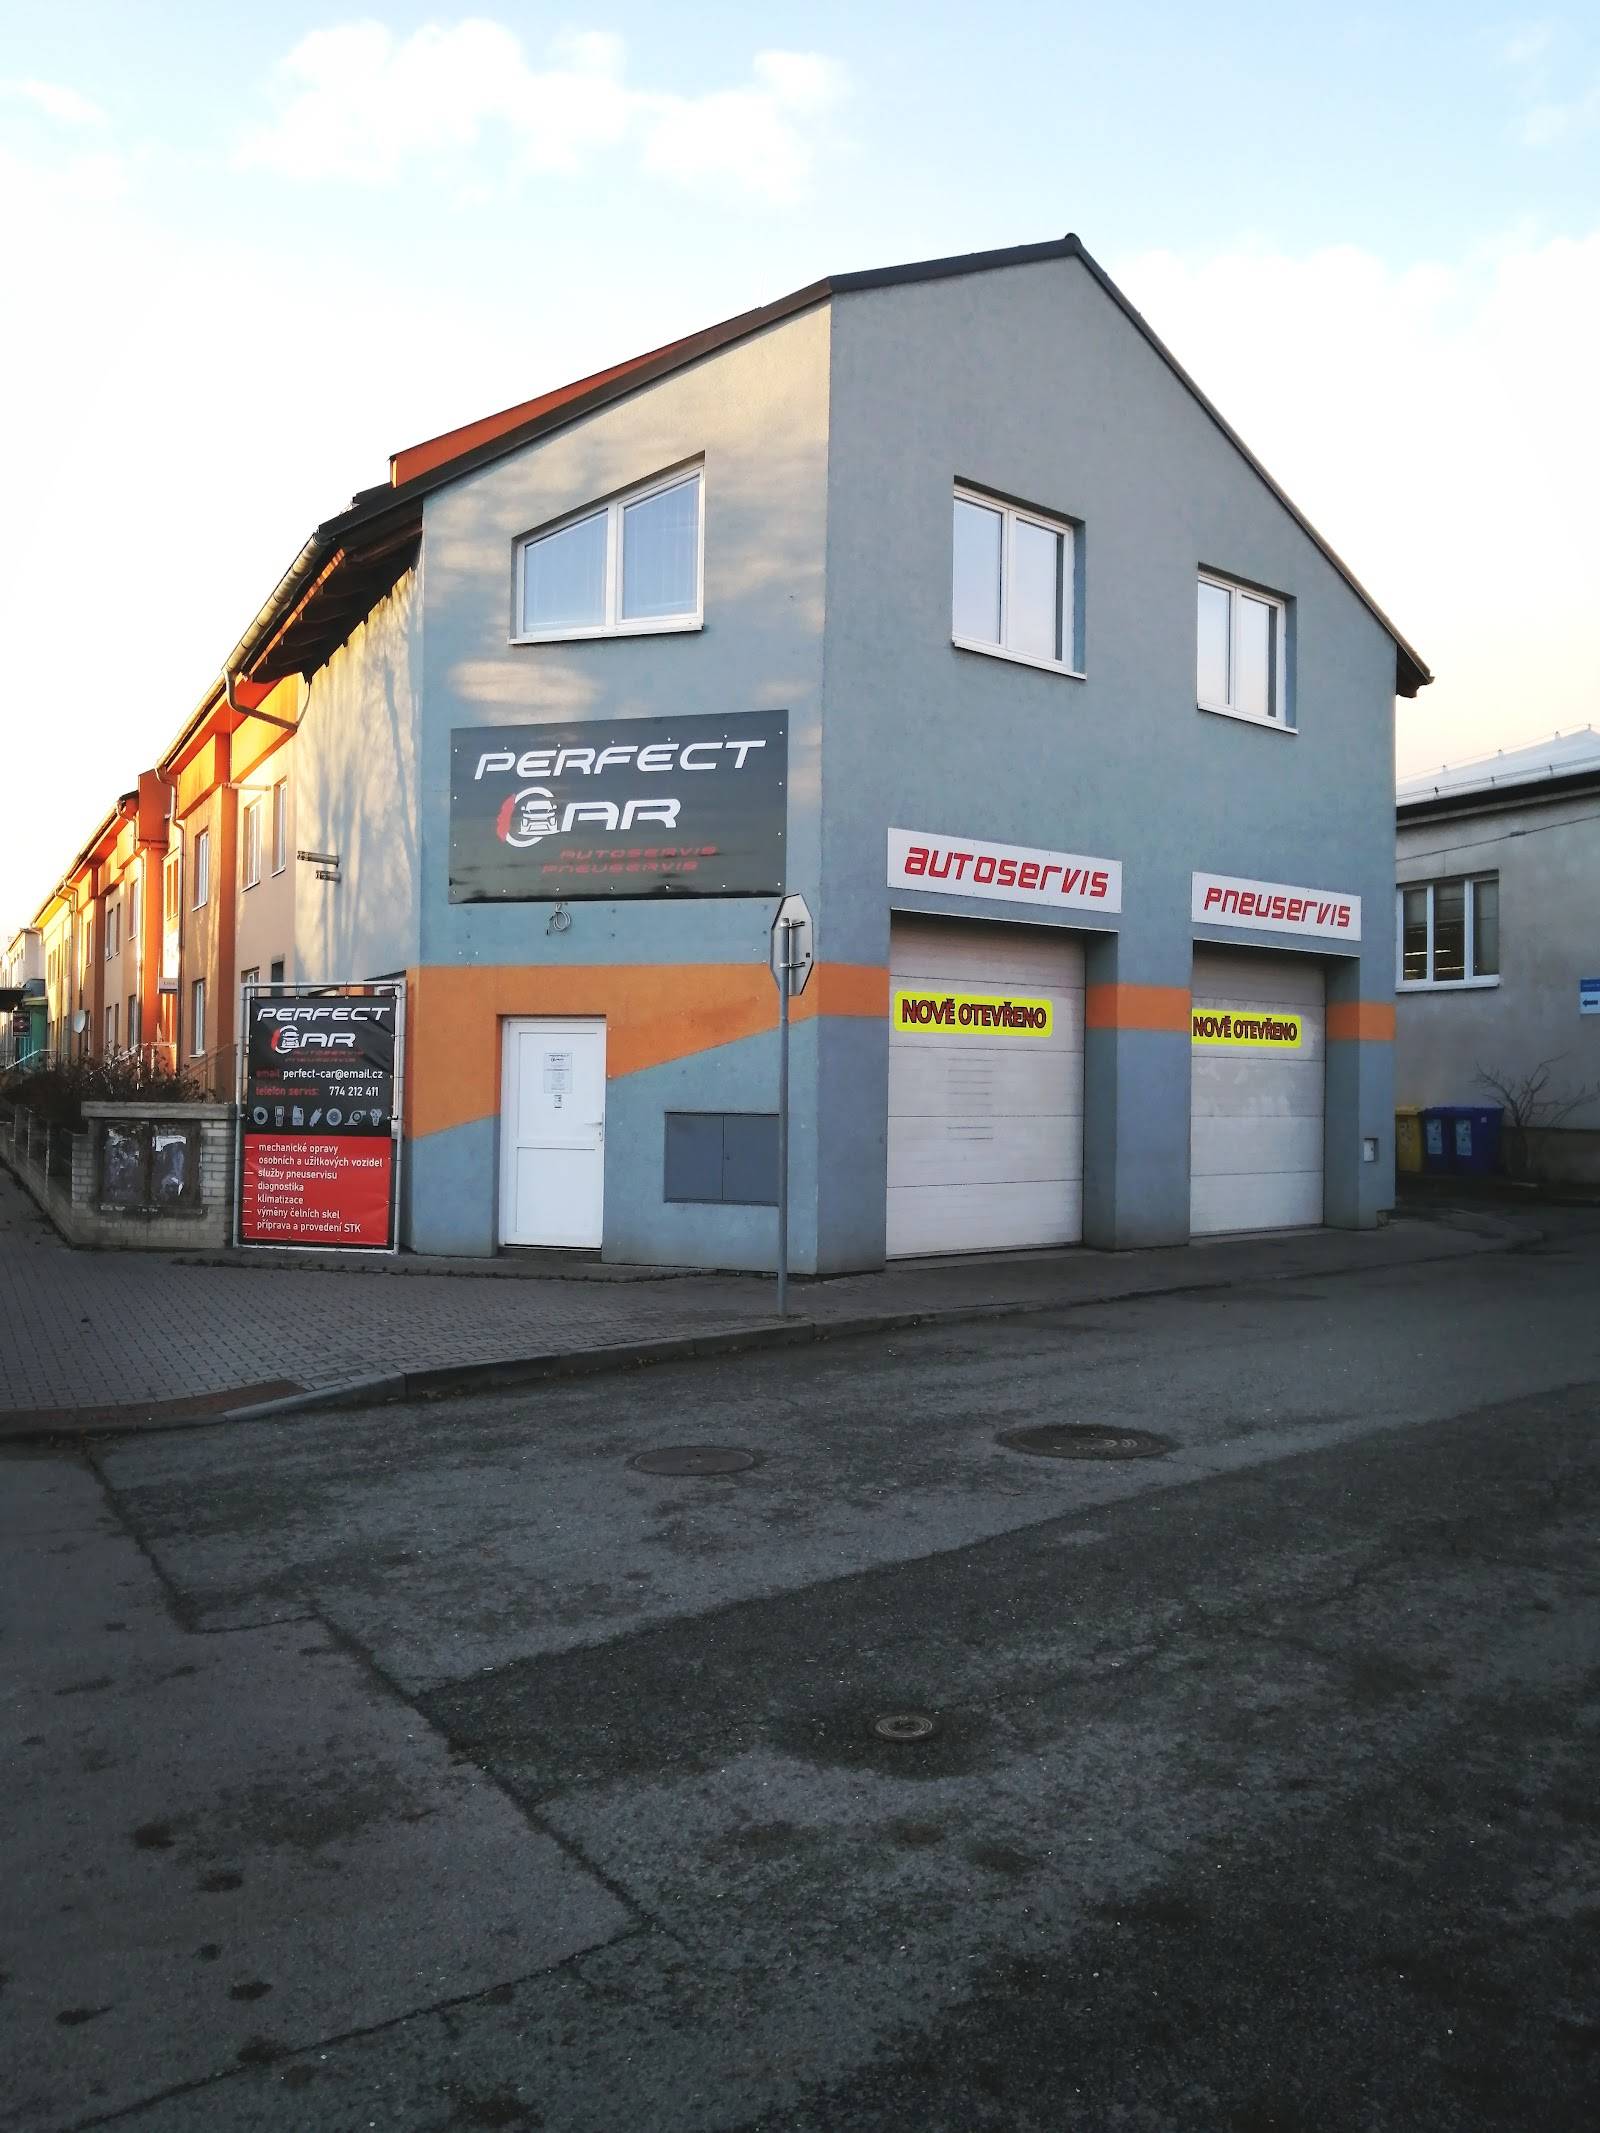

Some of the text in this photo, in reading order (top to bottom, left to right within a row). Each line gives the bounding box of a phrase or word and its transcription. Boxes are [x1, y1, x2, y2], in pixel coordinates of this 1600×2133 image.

[474, 740, 767, 780] PERFECT
[256, 1008, 390, 1022] PERFECT
[901, 998, 1047, 1029] NOVĚ OTEVŘENO
[1193, 1016, 1297, 1040] NOVĚ OTEVŘENO
[283, 1069, 383, 1080] perfect-car@email.cz
[329, 1086, 345, 1096] 774
[348, 1086, 363, 1096] 212
[365, 1086, 379, 1096] 411
[258, 1143, 339, 1155] mechanické opravy
[258, 1156, 295, 1166] osobních
[304, 1157, 349, 1168] užitkových
[351, 1159, 383, 1168] vozidel
[258, 1168, 338, 1180] služby pneuservisu
[257, 1182, 304, 1193] diagnostika
[257, 1194, 304, 1205] klimatizace
[256, 1207, 340, 1219] výměny čelních skel
[300, 1222, 342, 1233] provedení
[343, 1224, 361, 1233] STK
